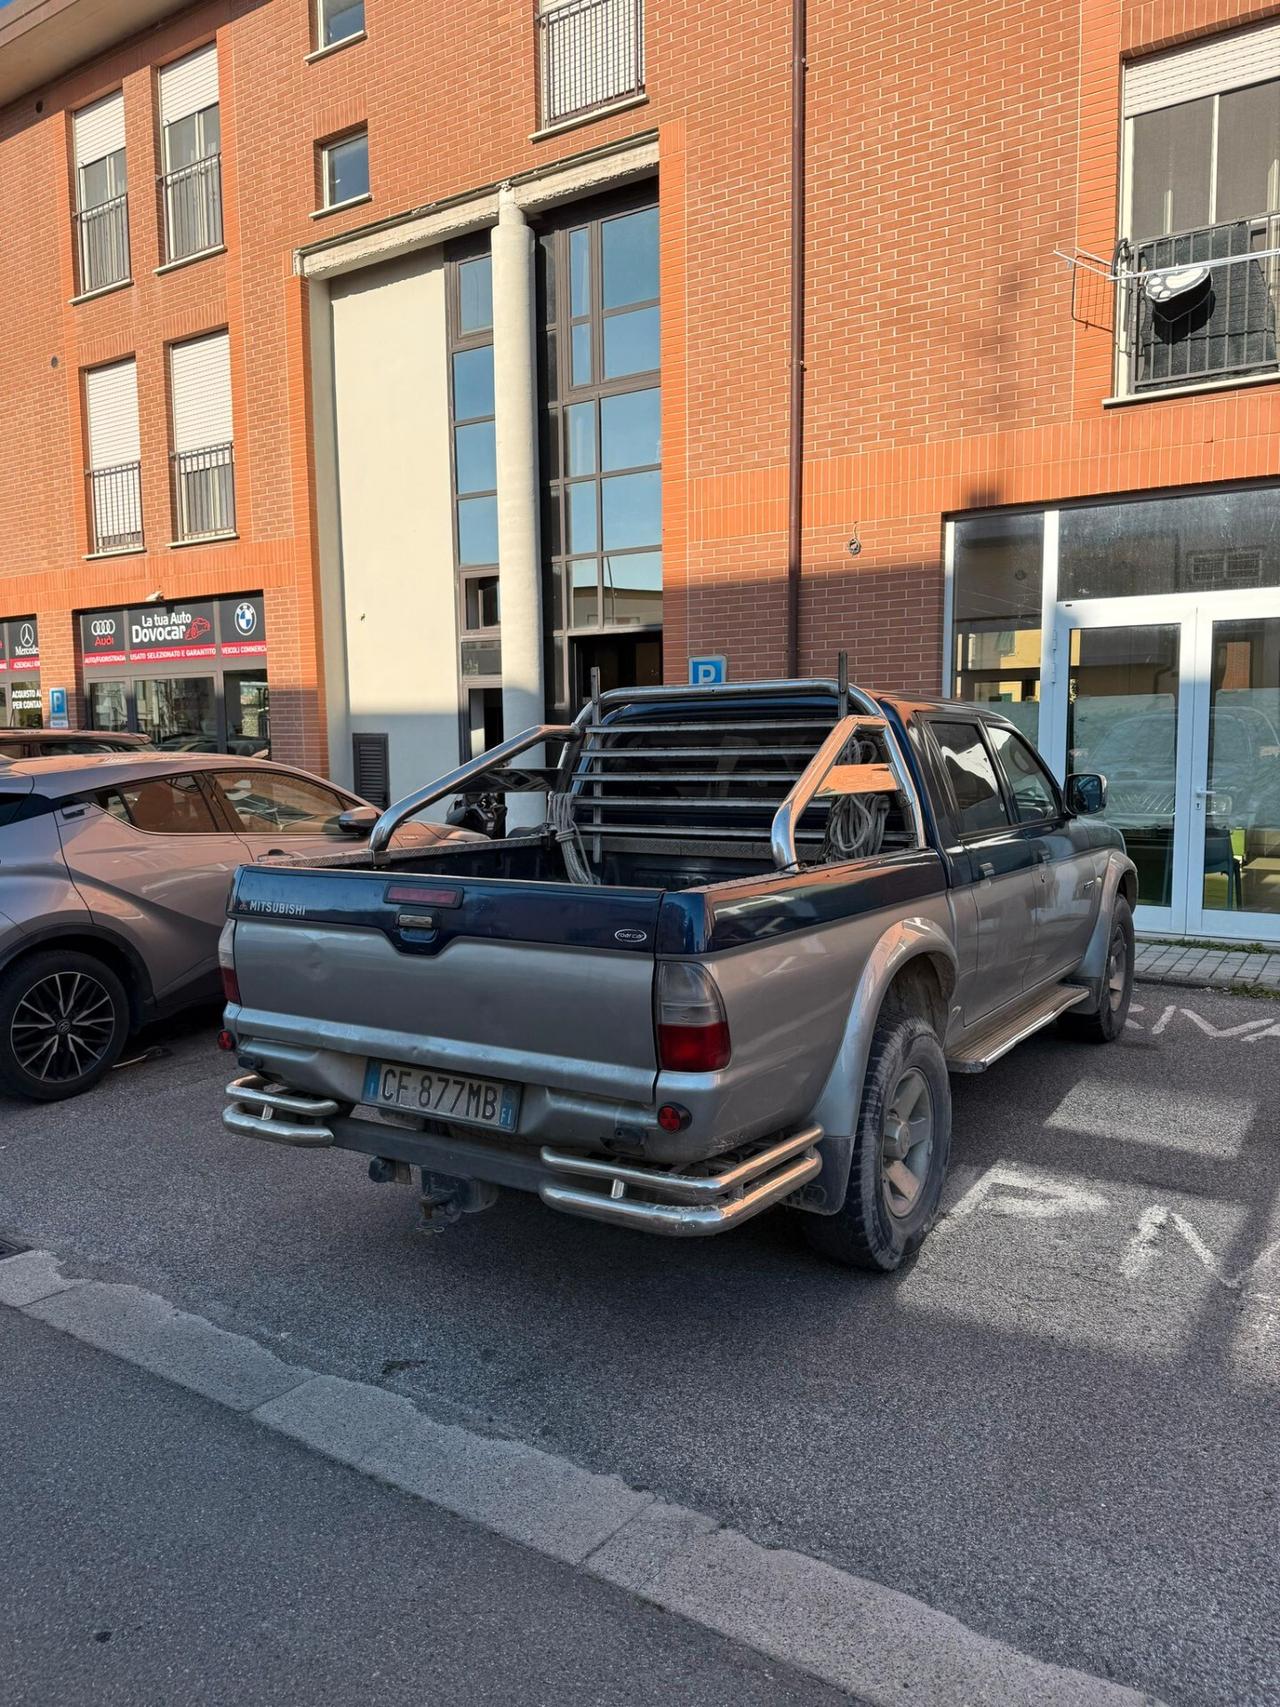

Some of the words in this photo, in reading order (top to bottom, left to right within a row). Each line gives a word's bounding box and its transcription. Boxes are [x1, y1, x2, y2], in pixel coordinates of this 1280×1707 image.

[142, 615, 153, 627] La
[154, 614, 169, 626] tua
[170, 611, 192, 625] Auto
[95, 635, 114, 646] Audi
[132, 625, 186, 643] Dovocar
[130, 652, 146, 661] USATO
[147, 649, 181, 660] SELEZIONATO
[186, 647, 216, 657] GARANTITO
[222, 646, 240, 655] VEICOLI
[698, 664, 716, 683] P
[12, 689, 35, 699] ACQUISTO
[53, 692, 62, 712] P
[249, 900, 306, 916] MITSUBISHI
[382, 1069, 412, 1103] CF
[418, 1075, 498, 1120] 877MB
[500, 1107, 513, 1124] FI
